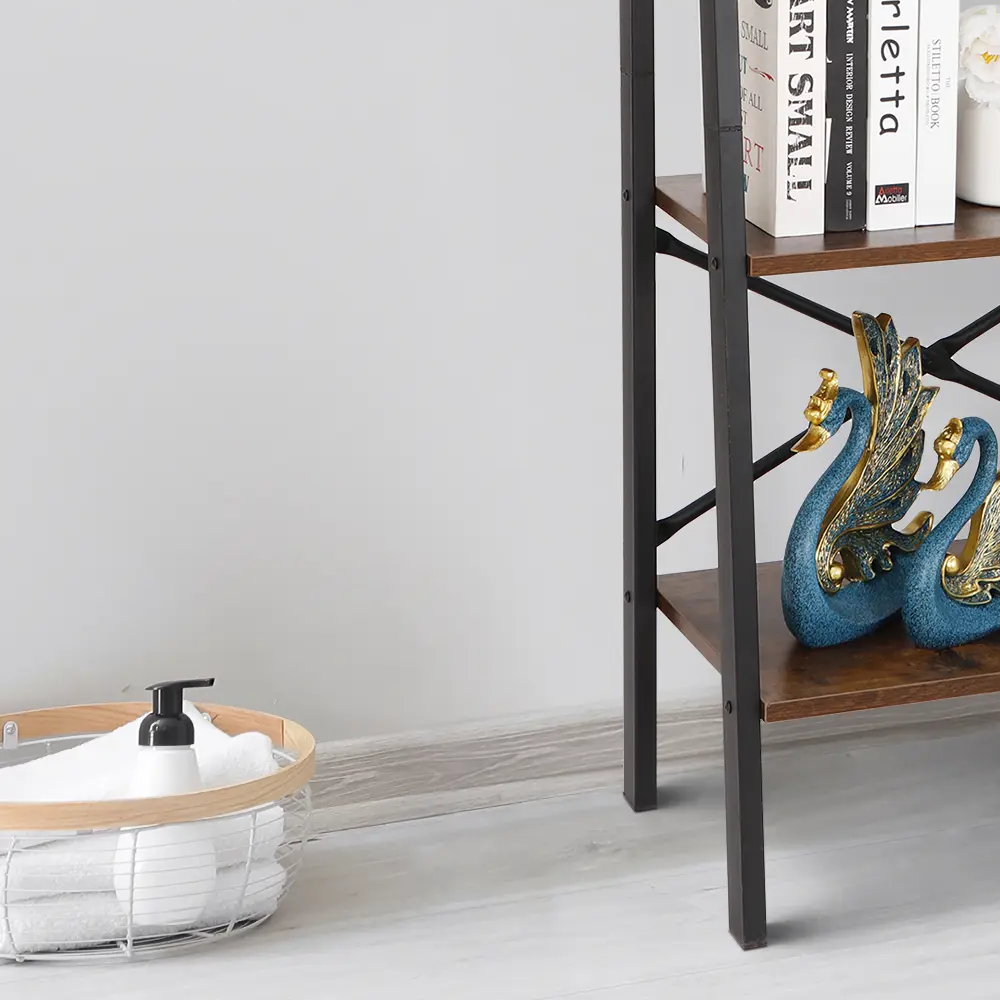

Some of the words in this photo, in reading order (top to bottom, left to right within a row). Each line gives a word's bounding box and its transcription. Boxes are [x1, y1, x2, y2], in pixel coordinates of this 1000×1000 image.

[740, 20, 769, 51] SMALL
[845, 6, 854, 44] MARTIN
[845, 52, 854, 91] INTERIOR
[931, 38, 942, 92] STILETTO
[749, 93, 763, 112] ALL
[845, 93, 853, 123] DESIGN
[930, 97, 941, 129] BOOK
[787, 73, 814, 202] SMALL
[845, 125, 853, 155] REVIEW
[742, 136, 765, 173] RT
[845, 161, 853, 190] VOLUME
